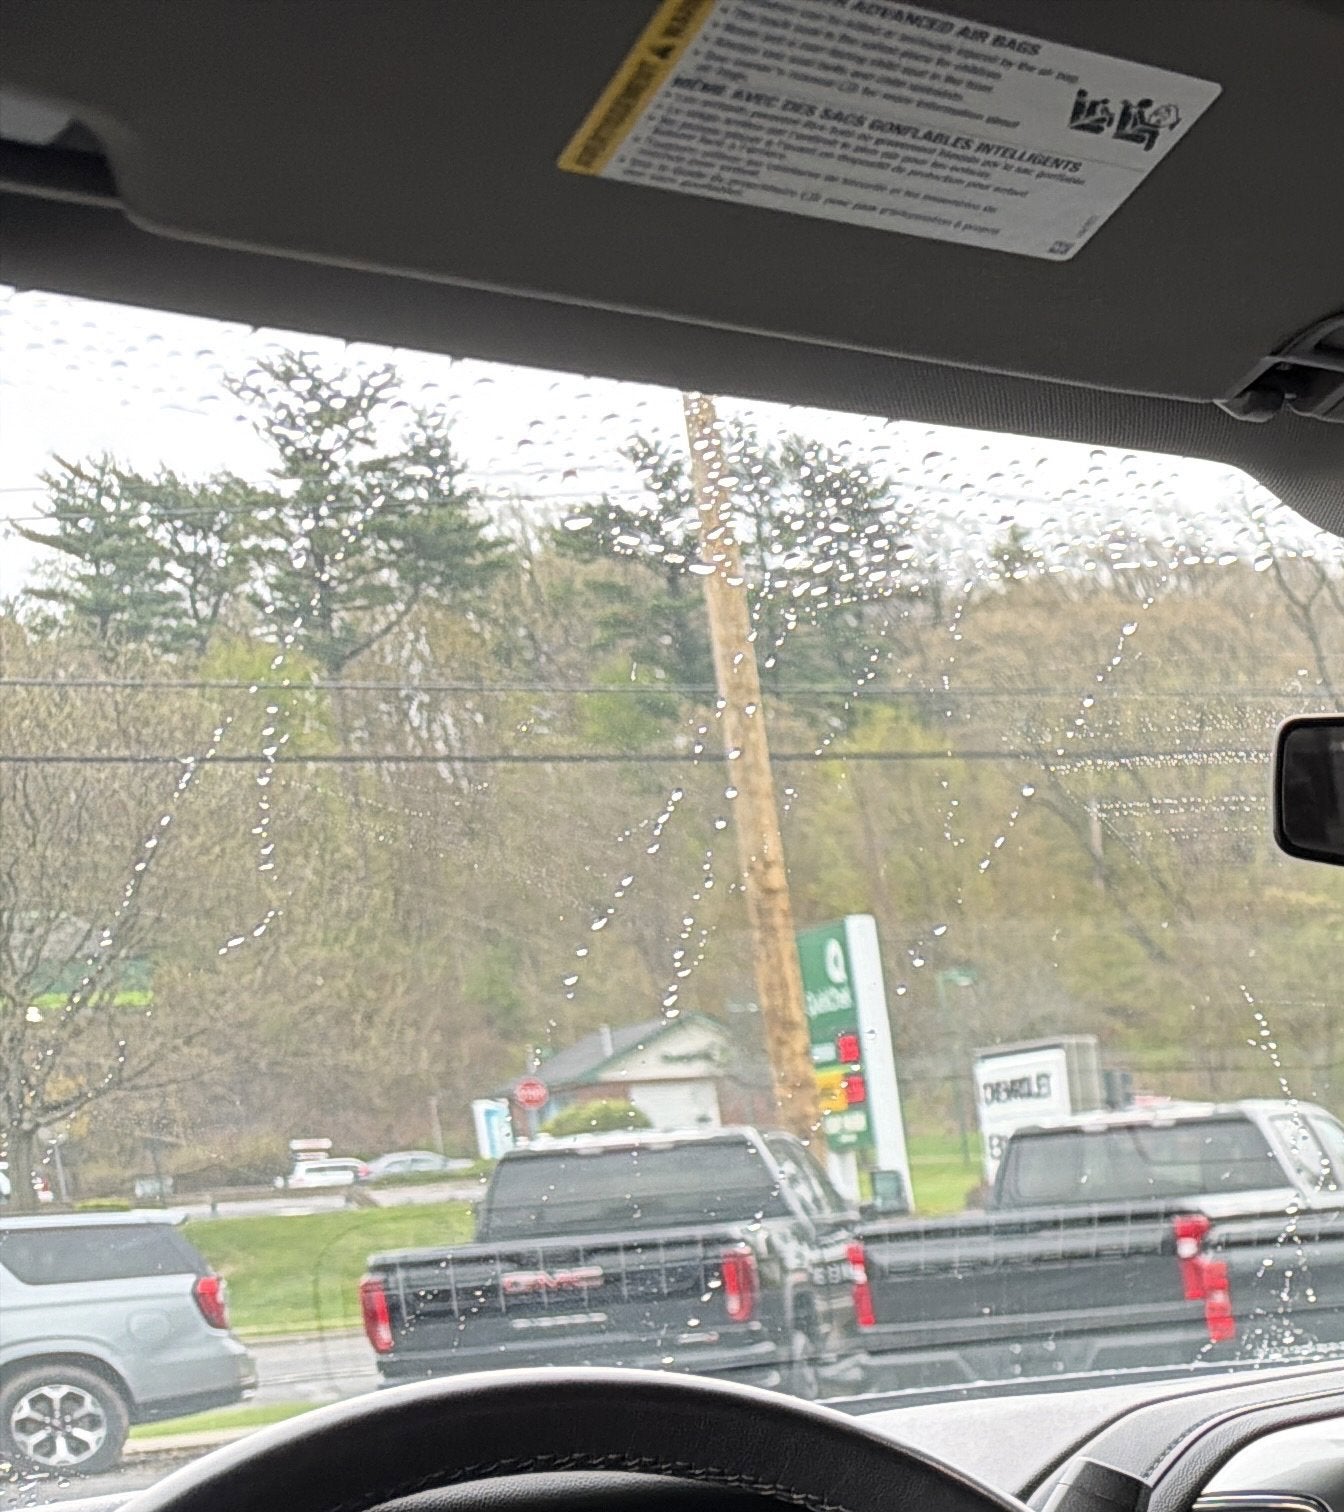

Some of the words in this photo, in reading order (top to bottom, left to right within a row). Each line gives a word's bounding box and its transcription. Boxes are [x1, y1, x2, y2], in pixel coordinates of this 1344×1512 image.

[956, 25, 990, 44] AIR
[992, 34, 1041, 56] BAGS
[820, 107, 866, 128] SACS
[974, 141, 1083, 173] INTELLIGENTS
